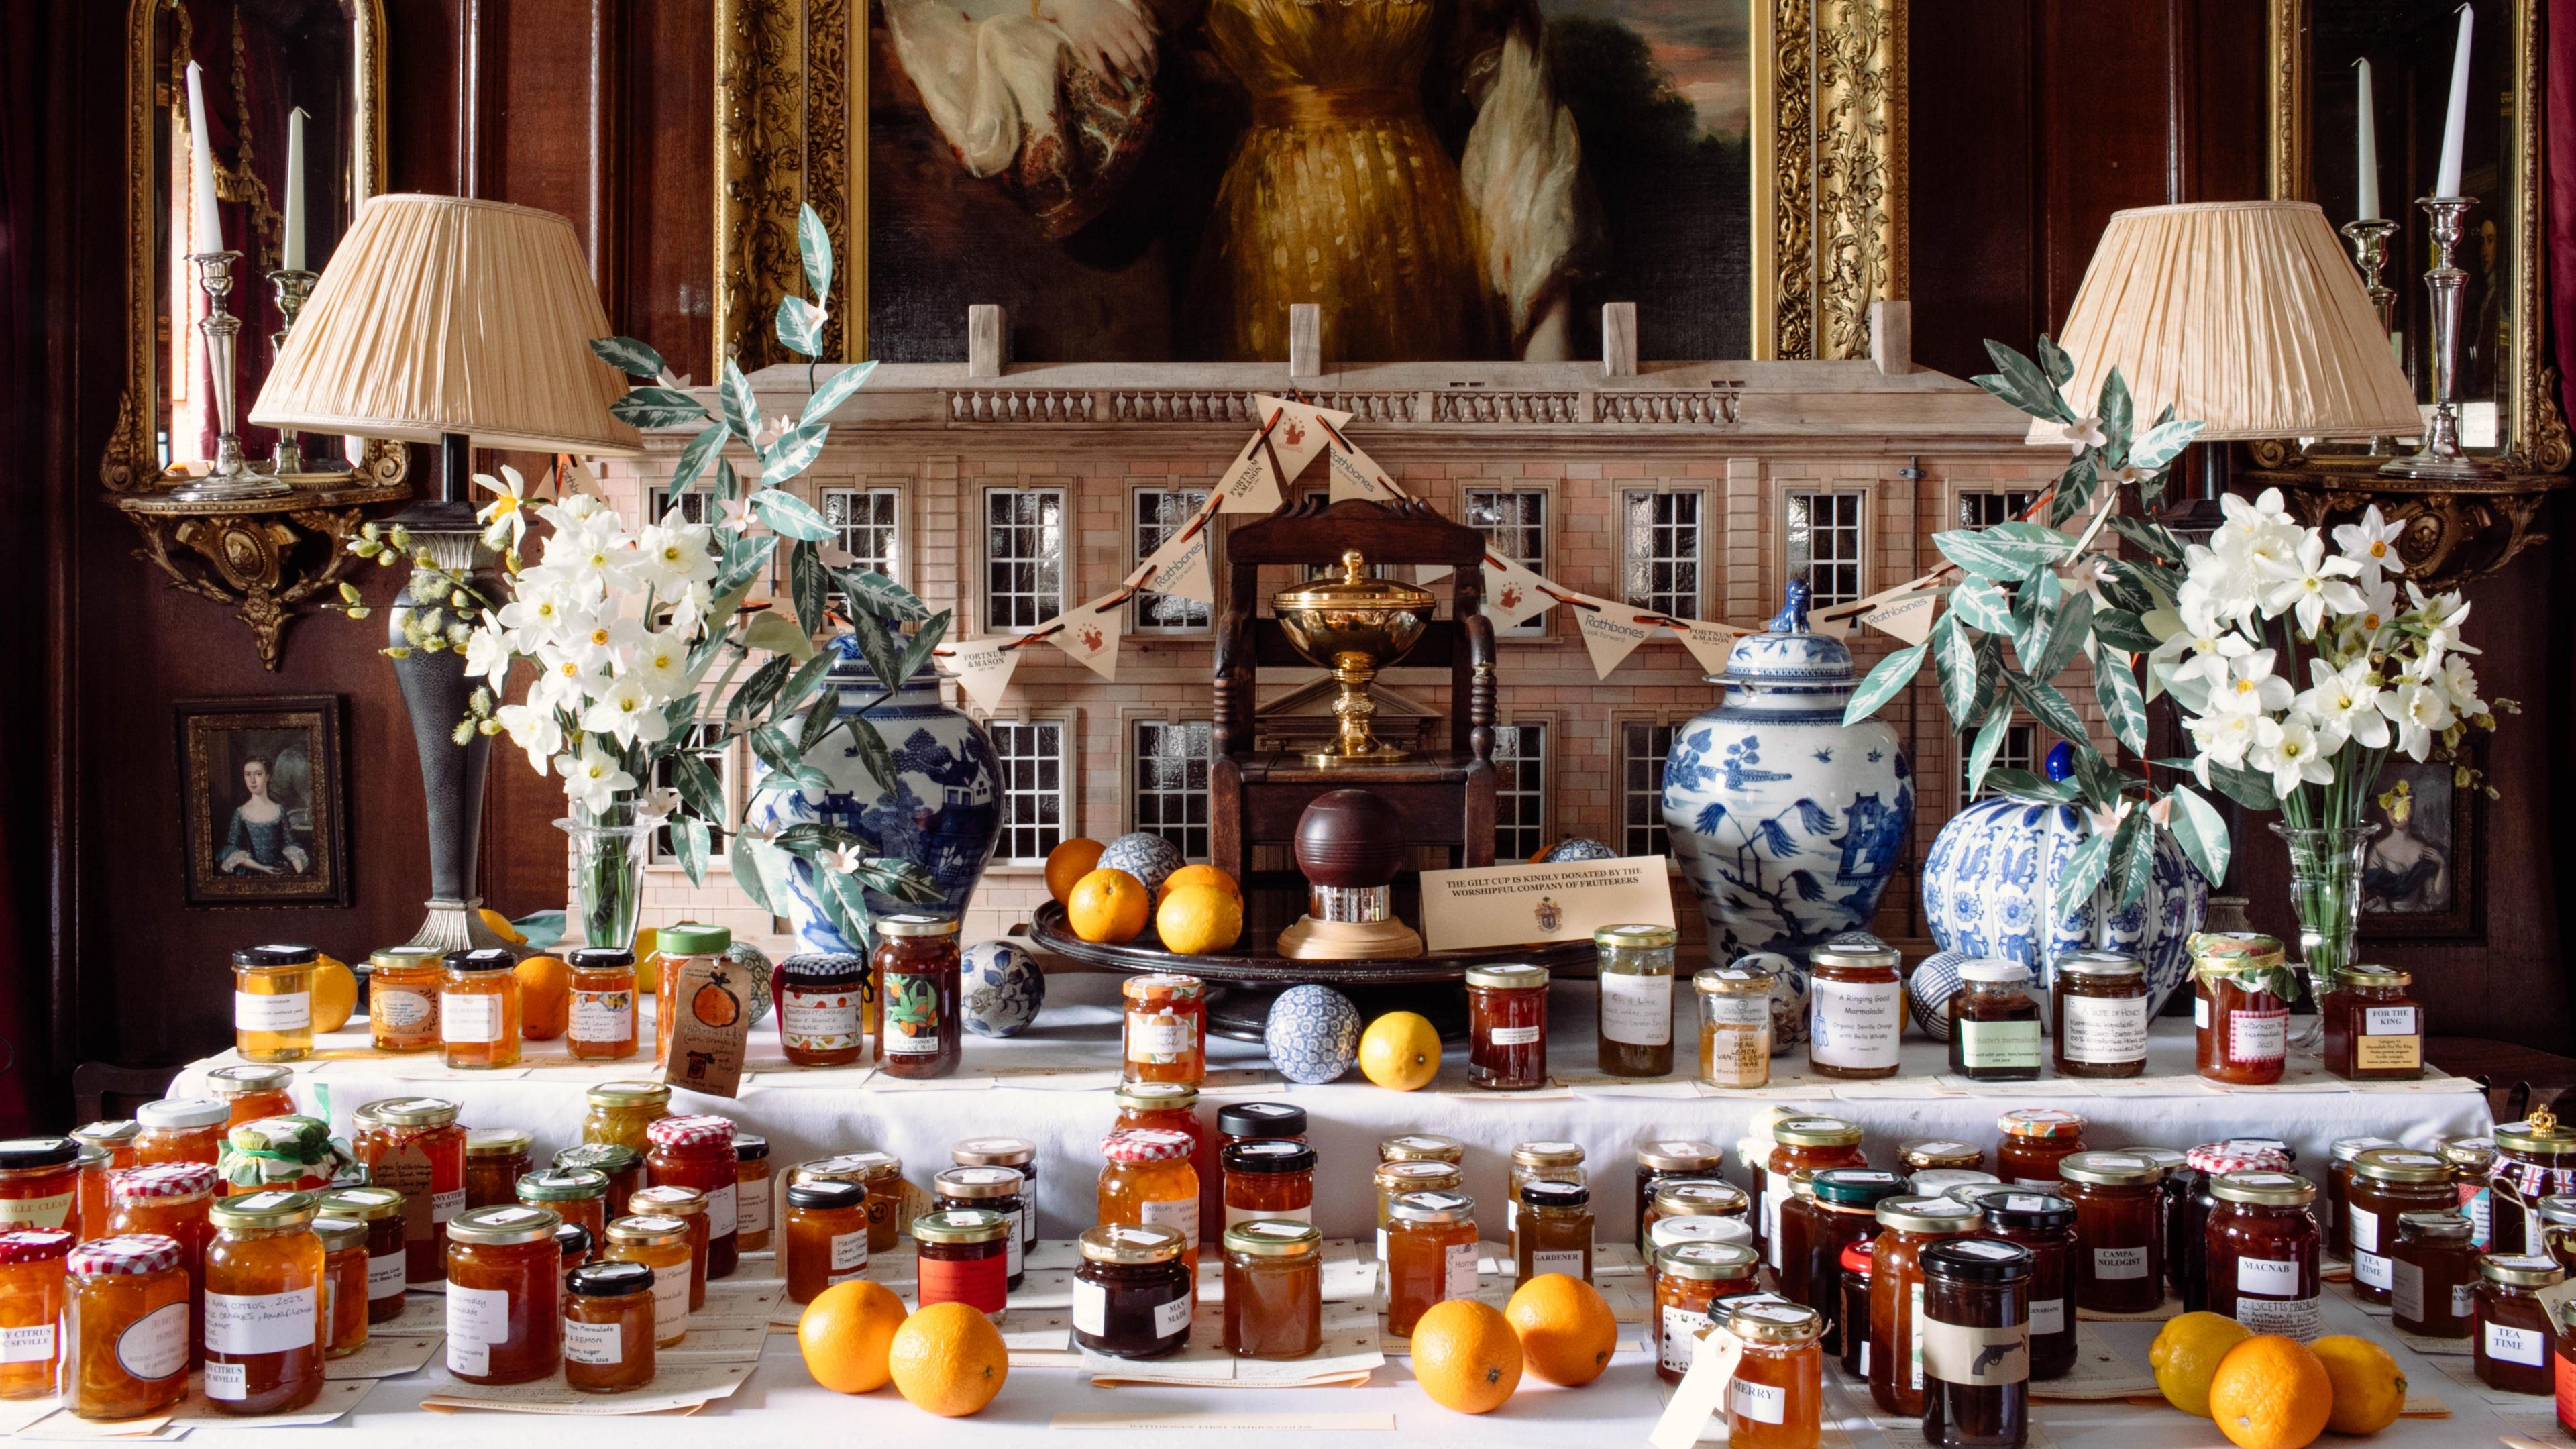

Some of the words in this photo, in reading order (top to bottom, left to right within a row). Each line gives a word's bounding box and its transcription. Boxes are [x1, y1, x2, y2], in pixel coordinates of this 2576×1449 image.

[1229, 459, 1260, 496] FORTNUM
[1236, 465, 1264, 498] &MASON
[1154, 541, 1204, 588] Rathbones
[1175, 560, 1197, 582] forward
[1867, 597, 1928, 625] Rathbones
[1585, 614, 1645, 639] Rathbones
[1582, 628, 1599, 637] Look
[1600, 630, 1626, 644] forward
[1689, 627, 1733, 639] FORTNUM
[1692, 634, 1729, 644] &MASON
[964, 649, 1006, 661] FORTNUM
[967, 657, 1005, 668] &MASON
[1446, 880, 1466, 888] THE
[1468, 879, 1490, 888] GILT
[1491, 876, 1511, 885] CUP
[1512, 875, 1522, 883] IS
[1523, 873, 1561, 883] KINDLY
[1562, 869, 1607, 880] DONATED
[1608, 868, 1621, 877] BY
[1621, 867, 1642, 875] THE
[1452, 885, 1516, 897] WORSHIPFUL
[1517, 881, 1564, 893] COMPANY
[1565, 881, 1578, 889] OF
[1580, 876, 1639, 888] FRUITERERS
[1847, 994, 1873, 1004] Ringing
[1874, 994, 1890, 1002] Good
[1844, 1007, 1886, 1015] Marmalade!
[1833, 1022, 1854, 1032] Organic
[1876, 1023, 1893, 1031] Orange
[2241, 1021, 2276, 1030] Afternoon
[1869, 1033, 1888, 1041] Whisky
[38, 1199, 68, 1211] CLEAR
[1534, 1253, 1579, 1262] GARDENER
[2098, 1258, 2141, 1267] NOLOGIST
[2363, 1254, 2380, 1267] TEA
[2243, 1260, 2290, 1273] MACNAB
[2361, 1264, 2383, 1277] TIME
[231, 1302, 266, 1310] CITRUS
[276, 1295, 304, 1307] 2023
[462, 1298, 486, 1308] Medley
[1169, 1301, 1185, 1313] MAN
[2238, 1299, 2248, 1309] 12
[1167, 1309, 1187, 1324] MADE
[13, 1328, 52, 1338] CITRUS
[580, 1324, 614, 1333] Marmalade
[2498, 1328, 2521, 1340] TEA
[12, 1337, 49, 1346] SEVILLE
[2493, 1338, 2524, 1351] TIME
[214, 1365, 244, 1375] CITRUS
[212, 1374, 241, 1383] SEVILLE
[1733, 1379, 1774, 1401] MERRY
